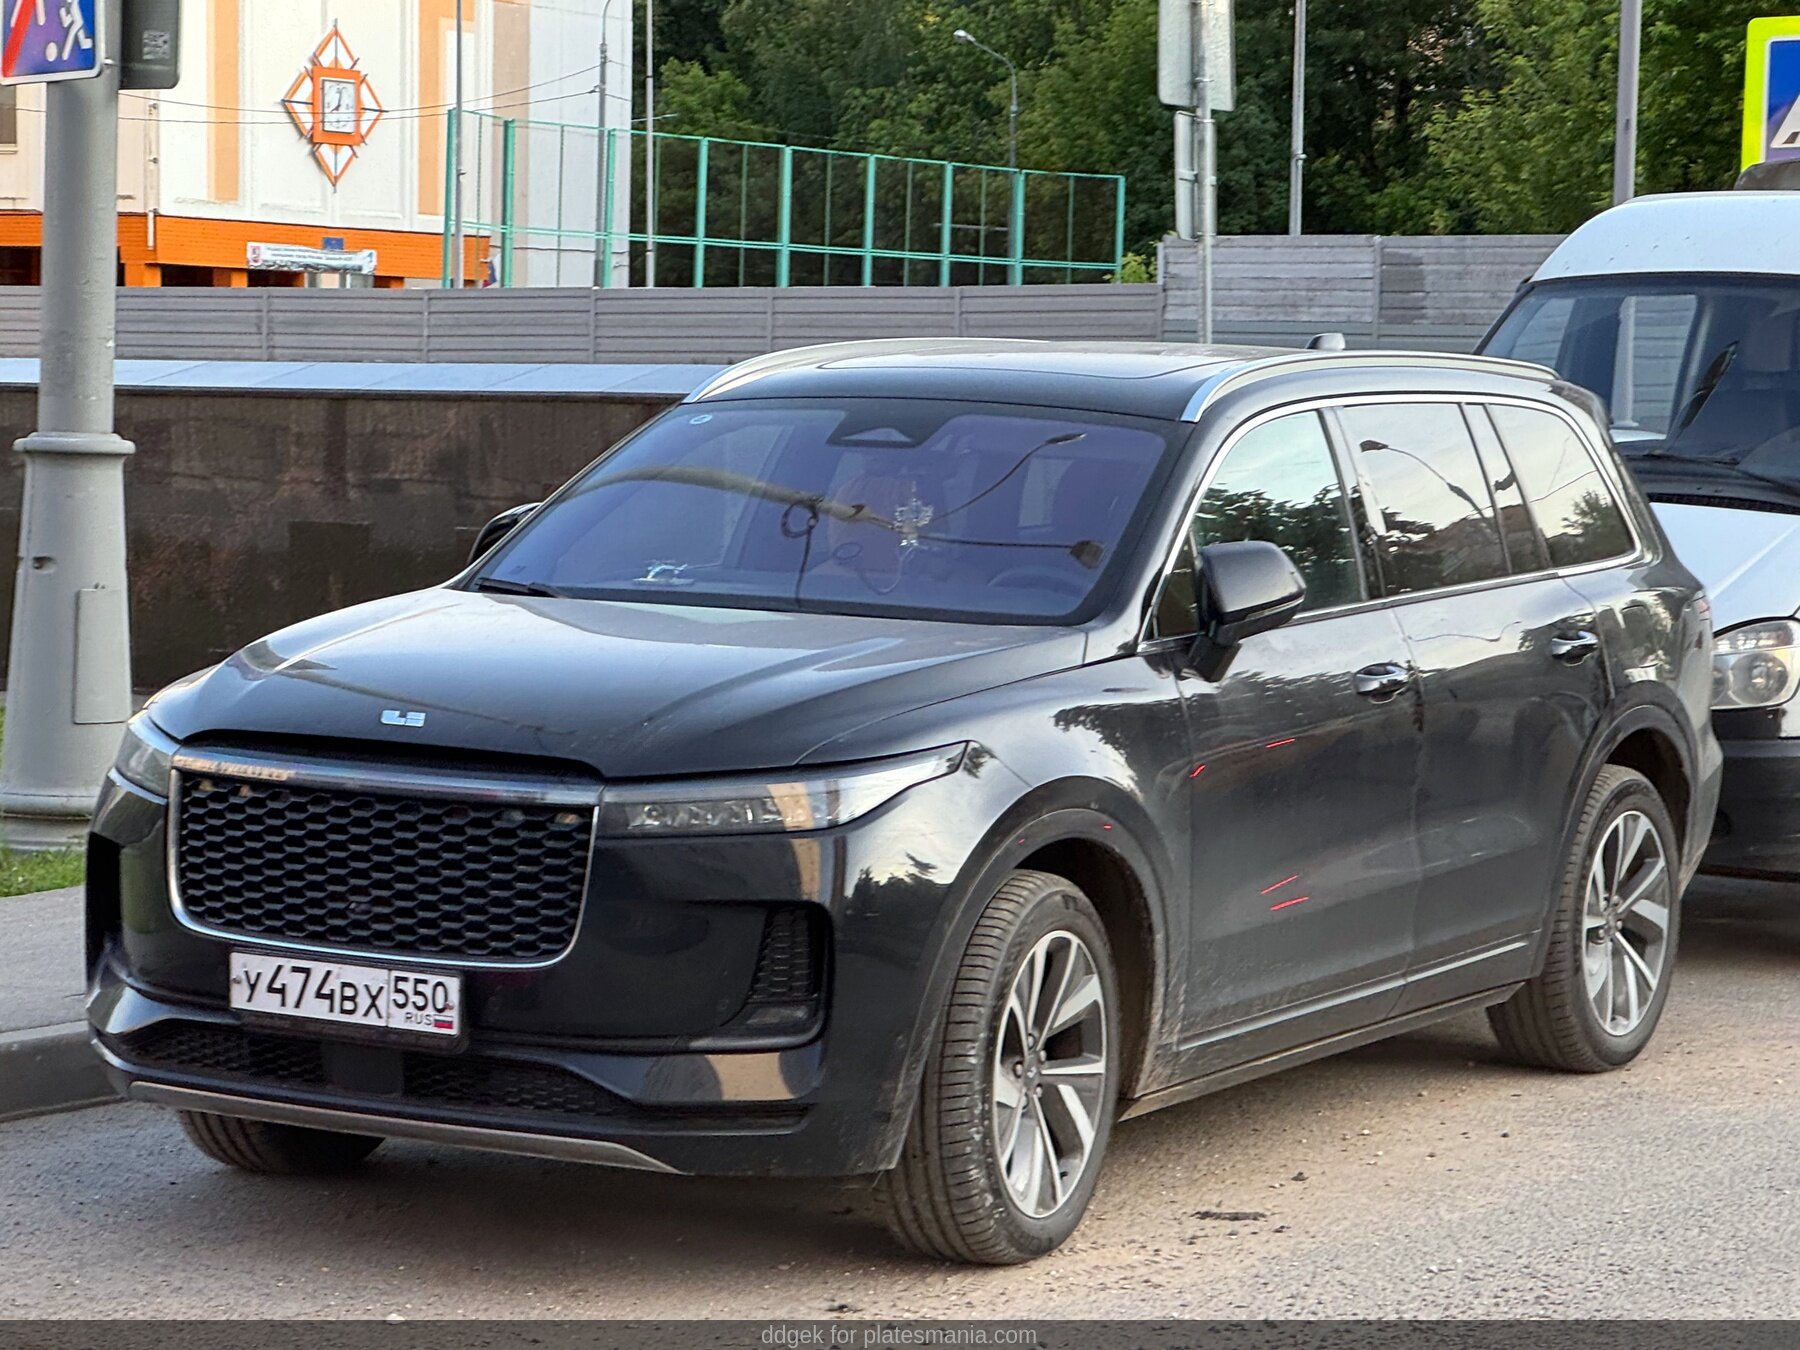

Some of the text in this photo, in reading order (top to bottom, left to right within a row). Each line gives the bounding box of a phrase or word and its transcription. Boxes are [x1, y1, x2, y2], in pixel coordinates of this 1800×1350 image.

[245, 964, 448, 1019] У474ВХ 550
[404, 1012, 432, 1026] RUS
